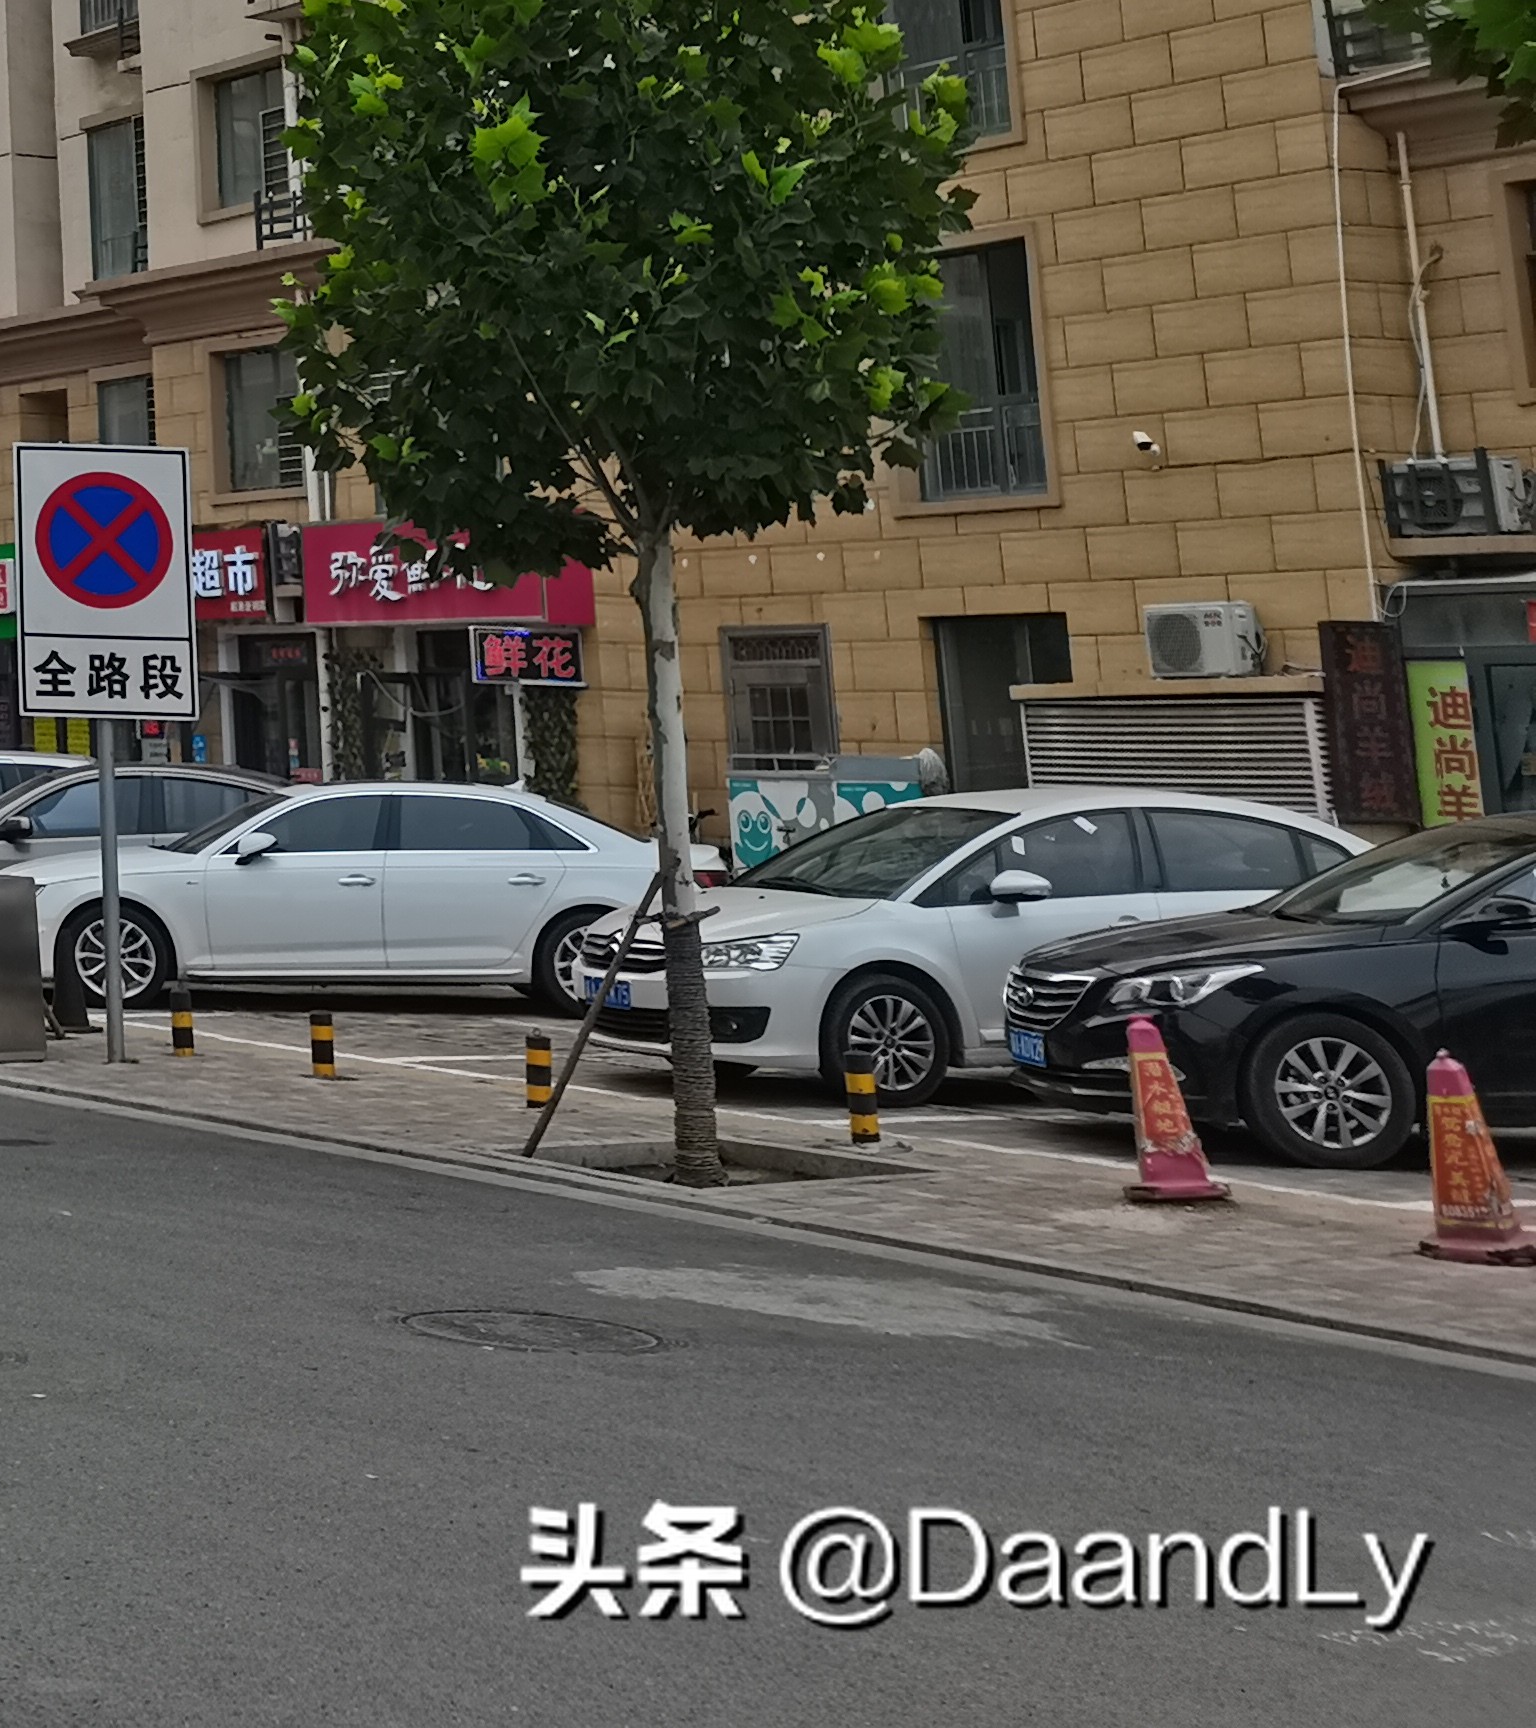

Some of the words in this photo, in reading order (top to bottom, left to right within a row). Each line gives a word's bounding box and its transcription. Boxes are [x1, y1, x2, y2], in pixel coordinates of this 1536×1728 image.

[192, 545, 259, 597] 超市
[33, 649, 185, 701] 全路段
[482, 634, 576, 679] 鲜花
